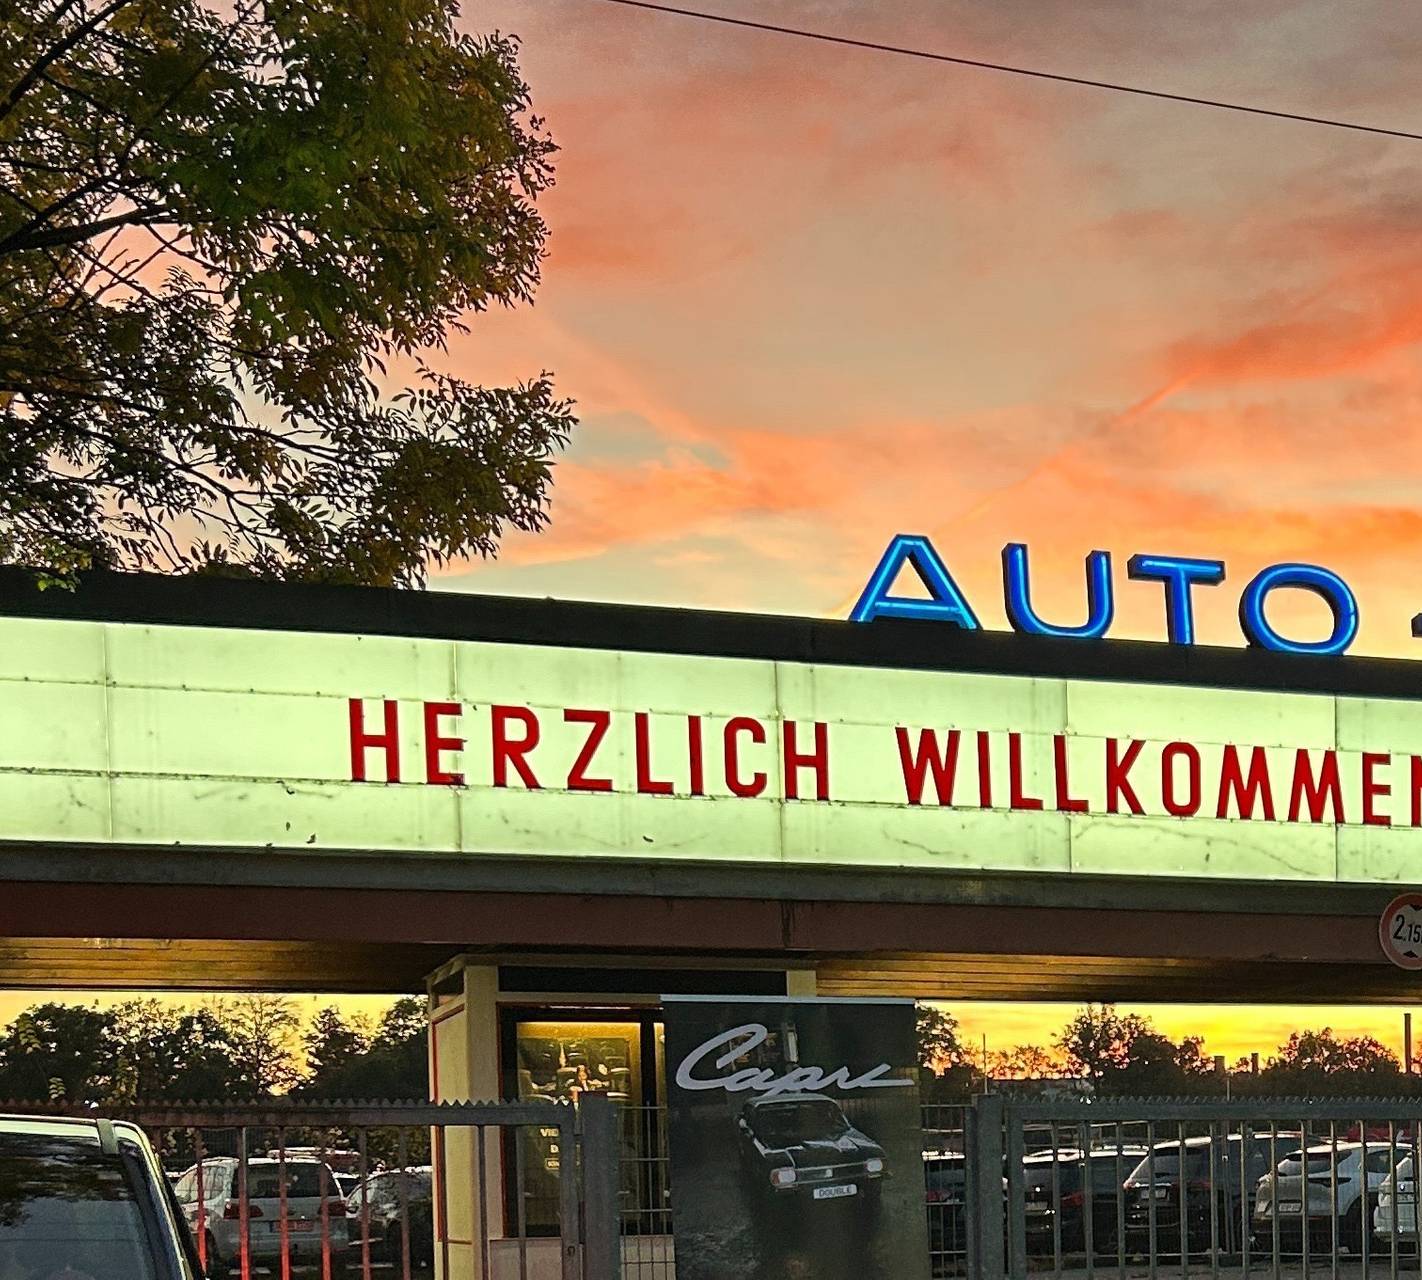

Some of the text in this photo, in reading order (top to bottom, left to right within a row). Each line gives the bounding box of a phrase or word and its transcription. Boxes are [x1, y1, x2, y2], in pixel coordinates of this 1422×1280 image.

[848, 534, 1359, 656] AUTO
[349, 699, 830, 804] HERZLICH
[676, 1023, 915, 1098] Capri
